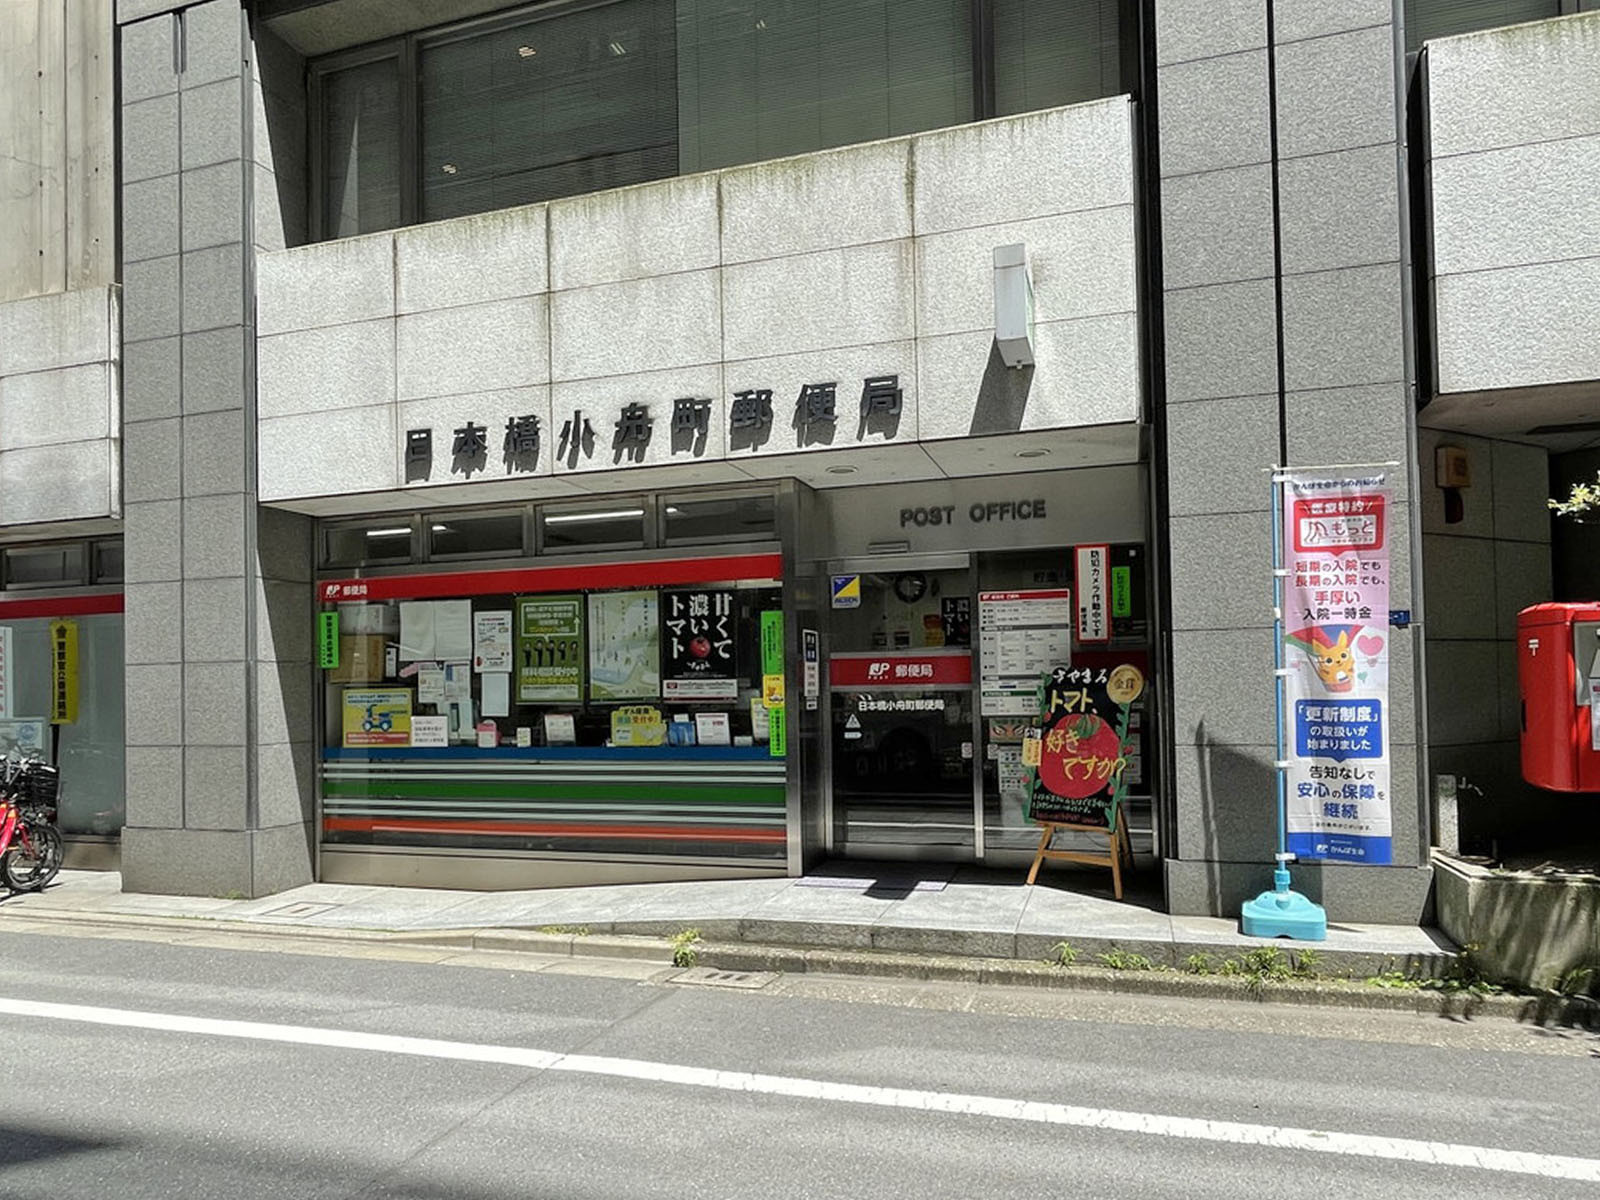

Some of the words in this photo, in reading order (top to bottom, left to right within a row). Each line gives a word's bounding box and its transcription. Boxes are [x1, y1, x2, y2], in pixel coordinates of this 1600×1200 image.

[406, 375, 903, 466] 日本橋小舟町郵便局
[900, 505, 955, 528] POST
[969, 499, 1047, 523] OFFICE
[1331, 520, 1374, 537] もっと
[1295, 558, 1382, 573] 短期の入院でも
[1295, 573, 1386, 588] 長期の入院でも、
[1314, 590, 1361, 606] 手厚い
[689, 594, 709, 635] 濃い
[1302, 606, 1372, 621] 入院一時金
[666, 595, 687, 660] トマト
[714, 593, 734, 659] 甘くて
[895, 664, 934, 678] 郵便局
[858, 699, 945, 712] 日本橋小舟町郵便局
[1298, 705, 1379, 723] 「更新制度」
[1309, 725, 1369, 737] の取扱いが
[1046, 728, 1080, 754] 好き
[1306, 738, 1372, 751] 始まりました
[1309, 765, 1376, 780] 告知なしで
[1297, 782, 1386, 800] 安心の保障を
[1323, 801, 1359, 820] 継続
